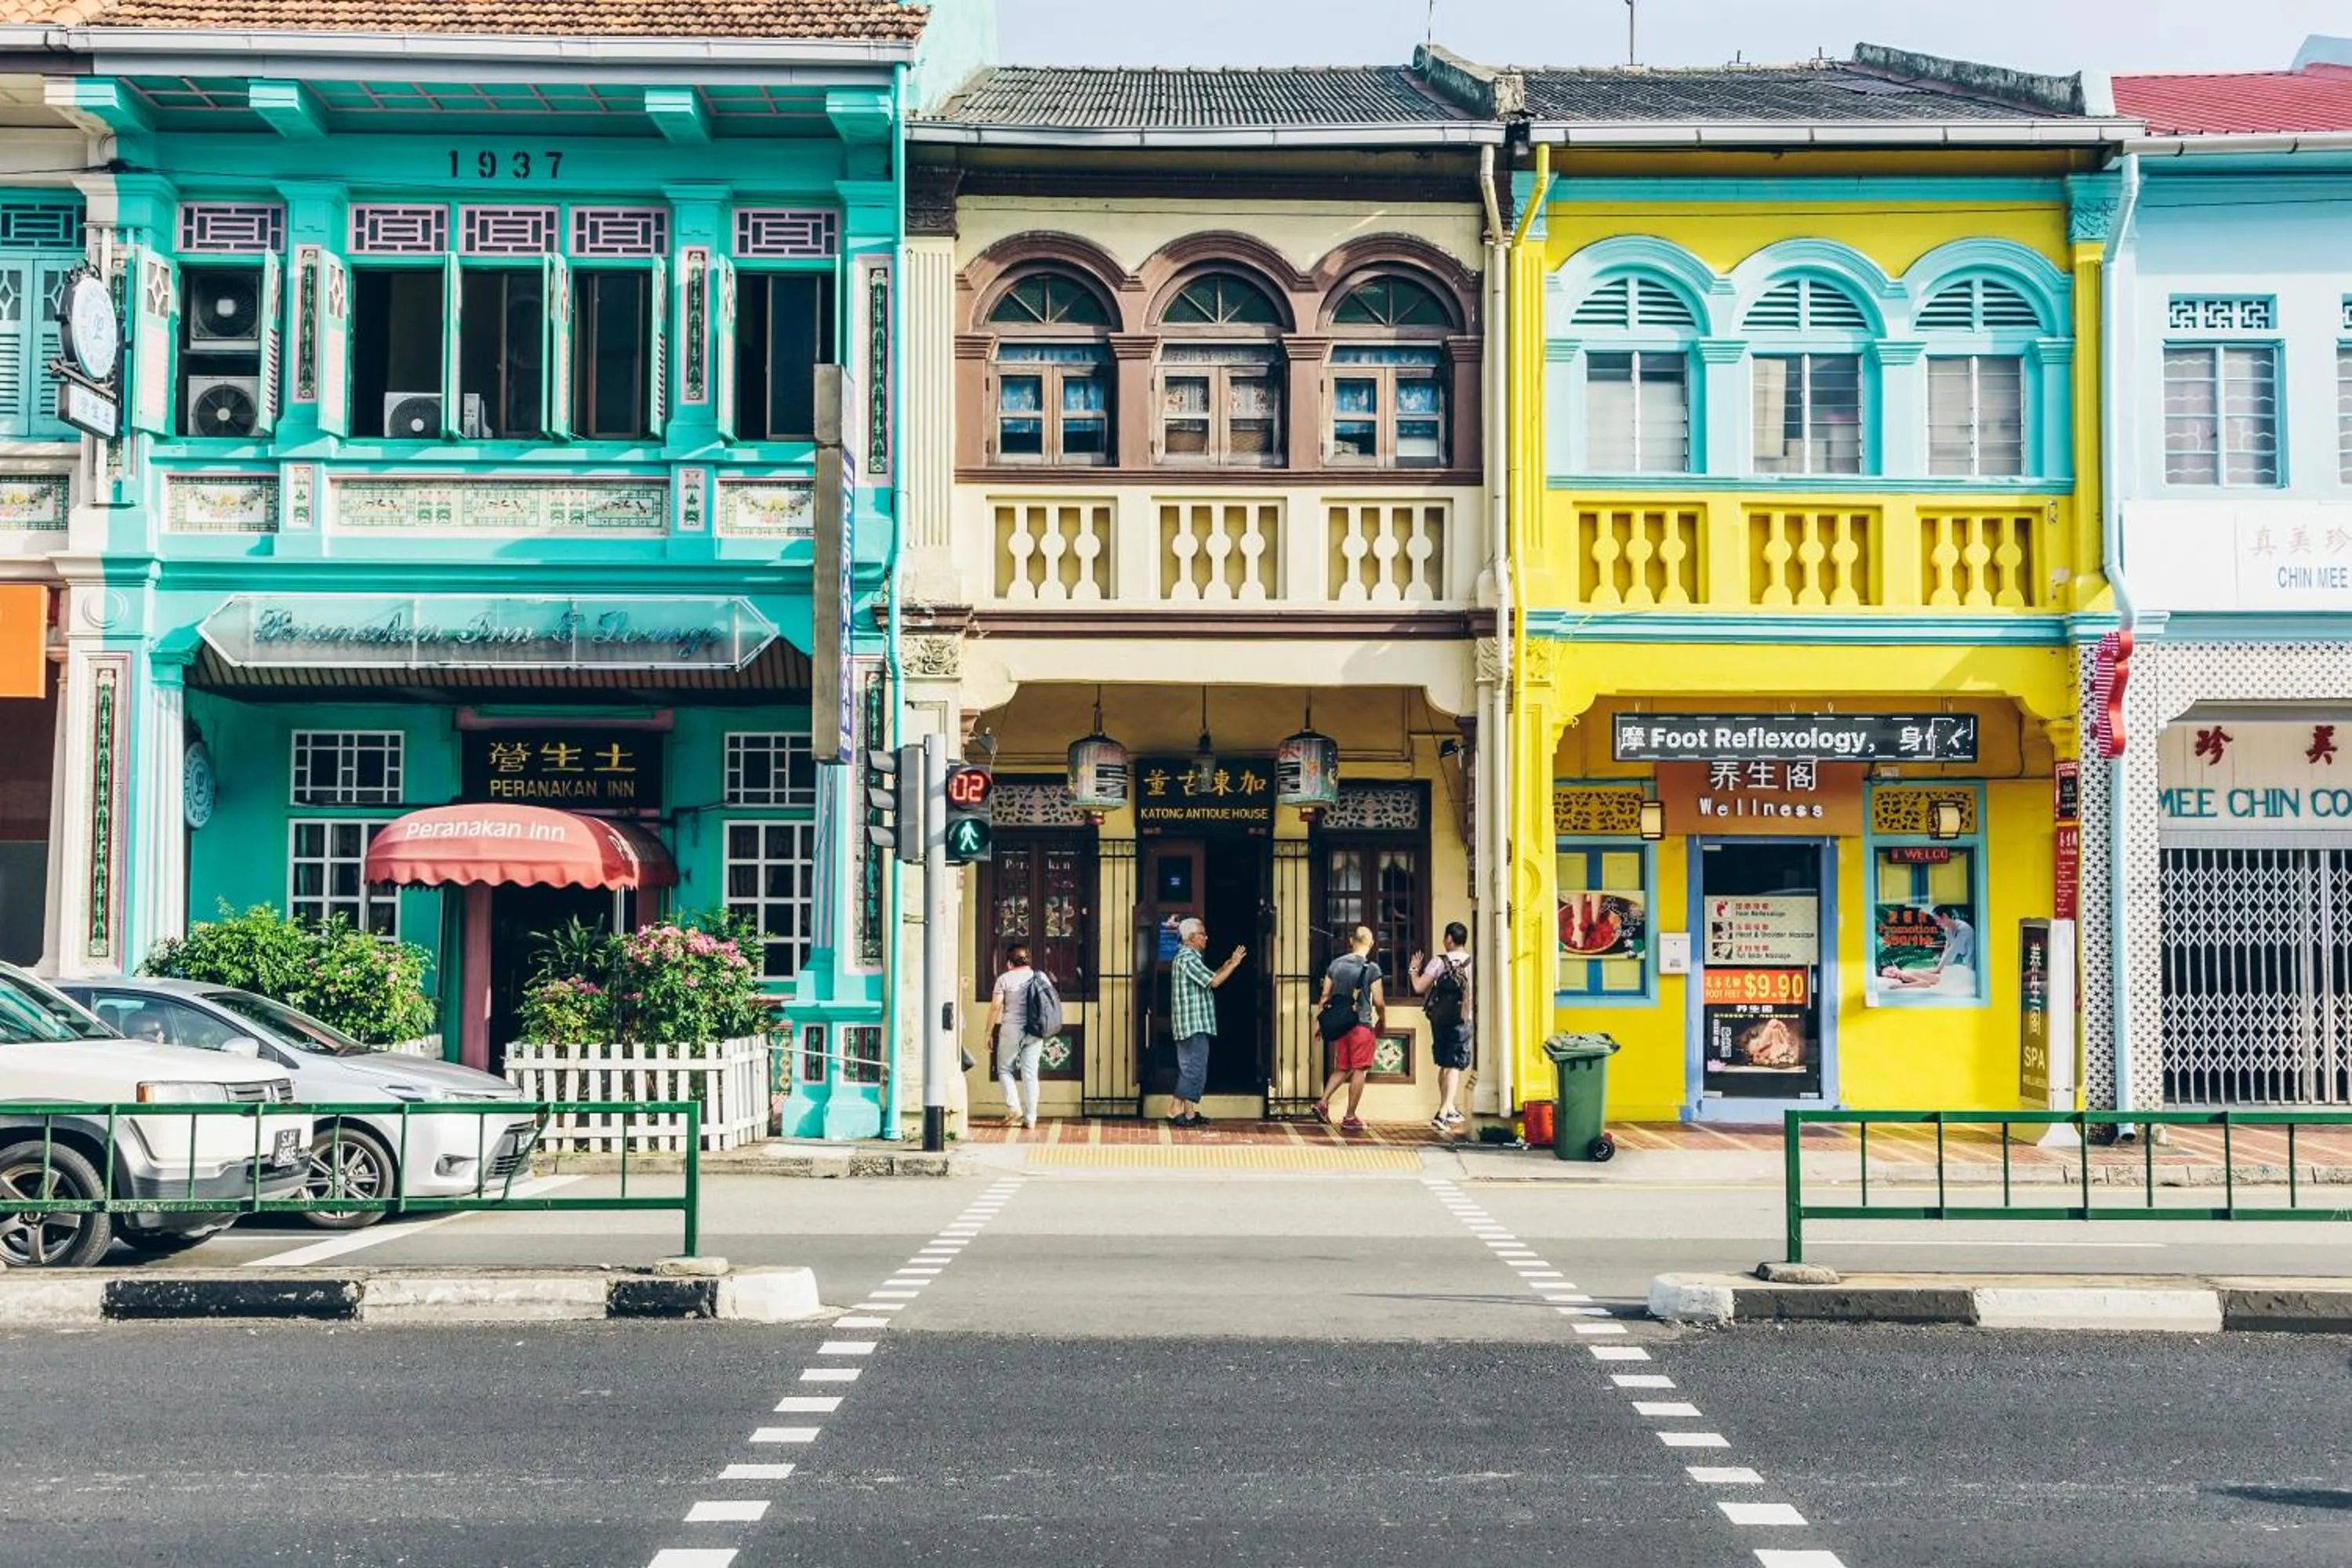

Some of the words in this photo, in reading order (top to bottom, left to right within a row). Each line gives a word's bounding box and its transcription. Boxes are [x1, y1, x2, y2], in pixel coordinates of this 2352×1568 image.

[448, 150, 564, 179] 1937
[2278, 566, 2312, 588] CHIN
[2318, 567, 2348, 588] MEE
[1650, 727, 1708, 748] Foot
[1710, 760, 1818, 791] 养生阁
[489, 779, 597, 797] PERANAKAN
[607, 779, 635, 797] INN
[952, 774, 984, 802] 02
[1141, 808, 1184, 819] KATONG
[1185, 808, 1230, 819] ANTIQUE
[1232, 808, 1269, 819] HOUSE
[1699, 797, 1824, 818] Wellness
[2157, 788, 2218, 817] MEE
[2227, 788, 2299, 817] CHIN
[405, 819, 522, 840] Peranakan
[529, 821, 566, 841] Inn
[1744, 972, 1804, 1000] $9.90
[2023, 1045, 2045, 1070] SPA
